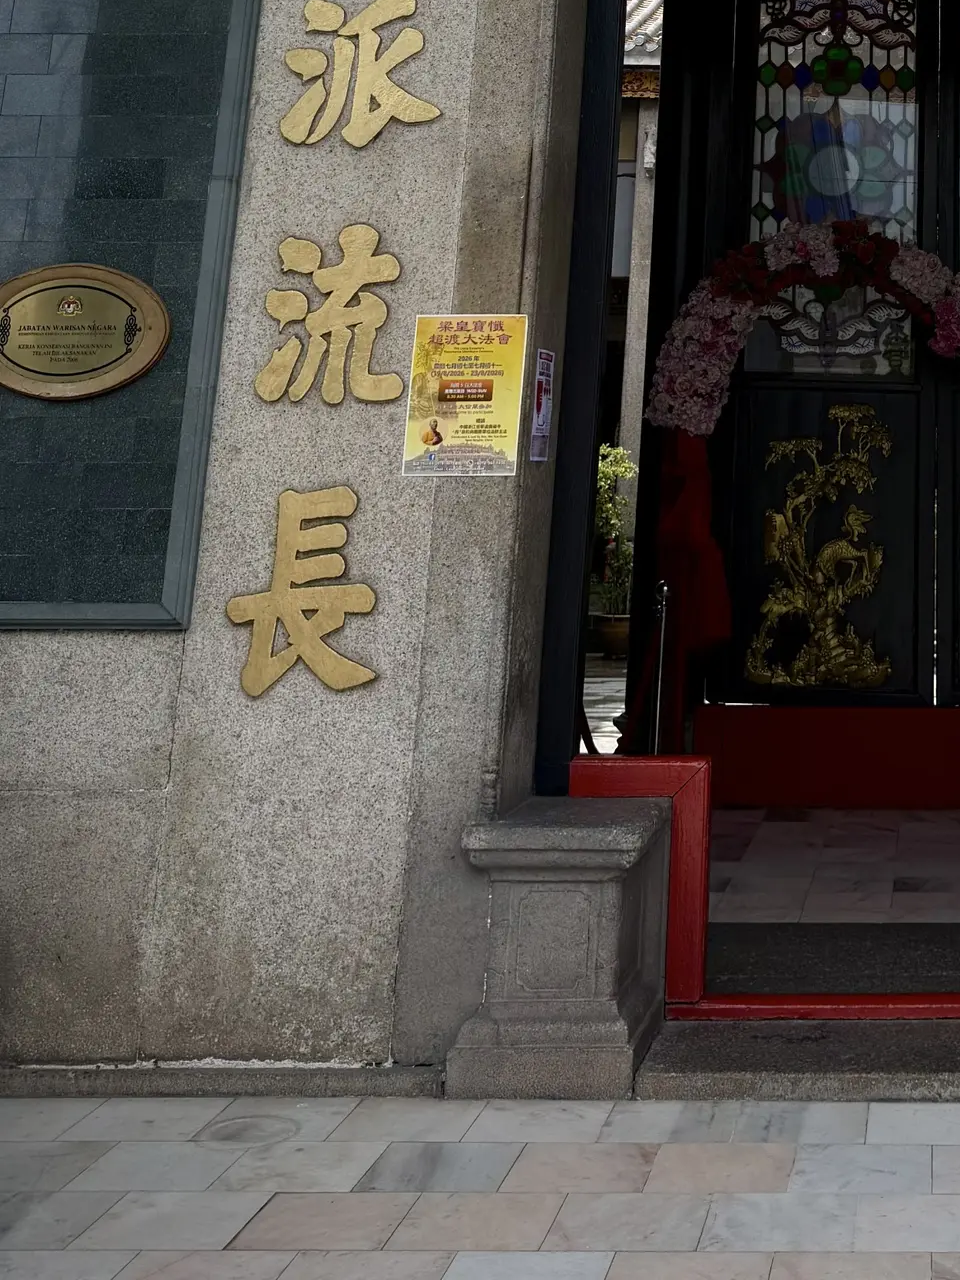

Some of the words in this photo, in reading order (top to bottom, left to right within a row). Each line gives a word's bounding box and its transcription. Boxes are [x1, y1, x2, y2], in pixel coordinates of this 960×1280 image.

[18, 324, 51, 332] JABATAN
[53, 324, 86, 332] WARISAN
[428, 333, 513, 345] 超渡大法會
